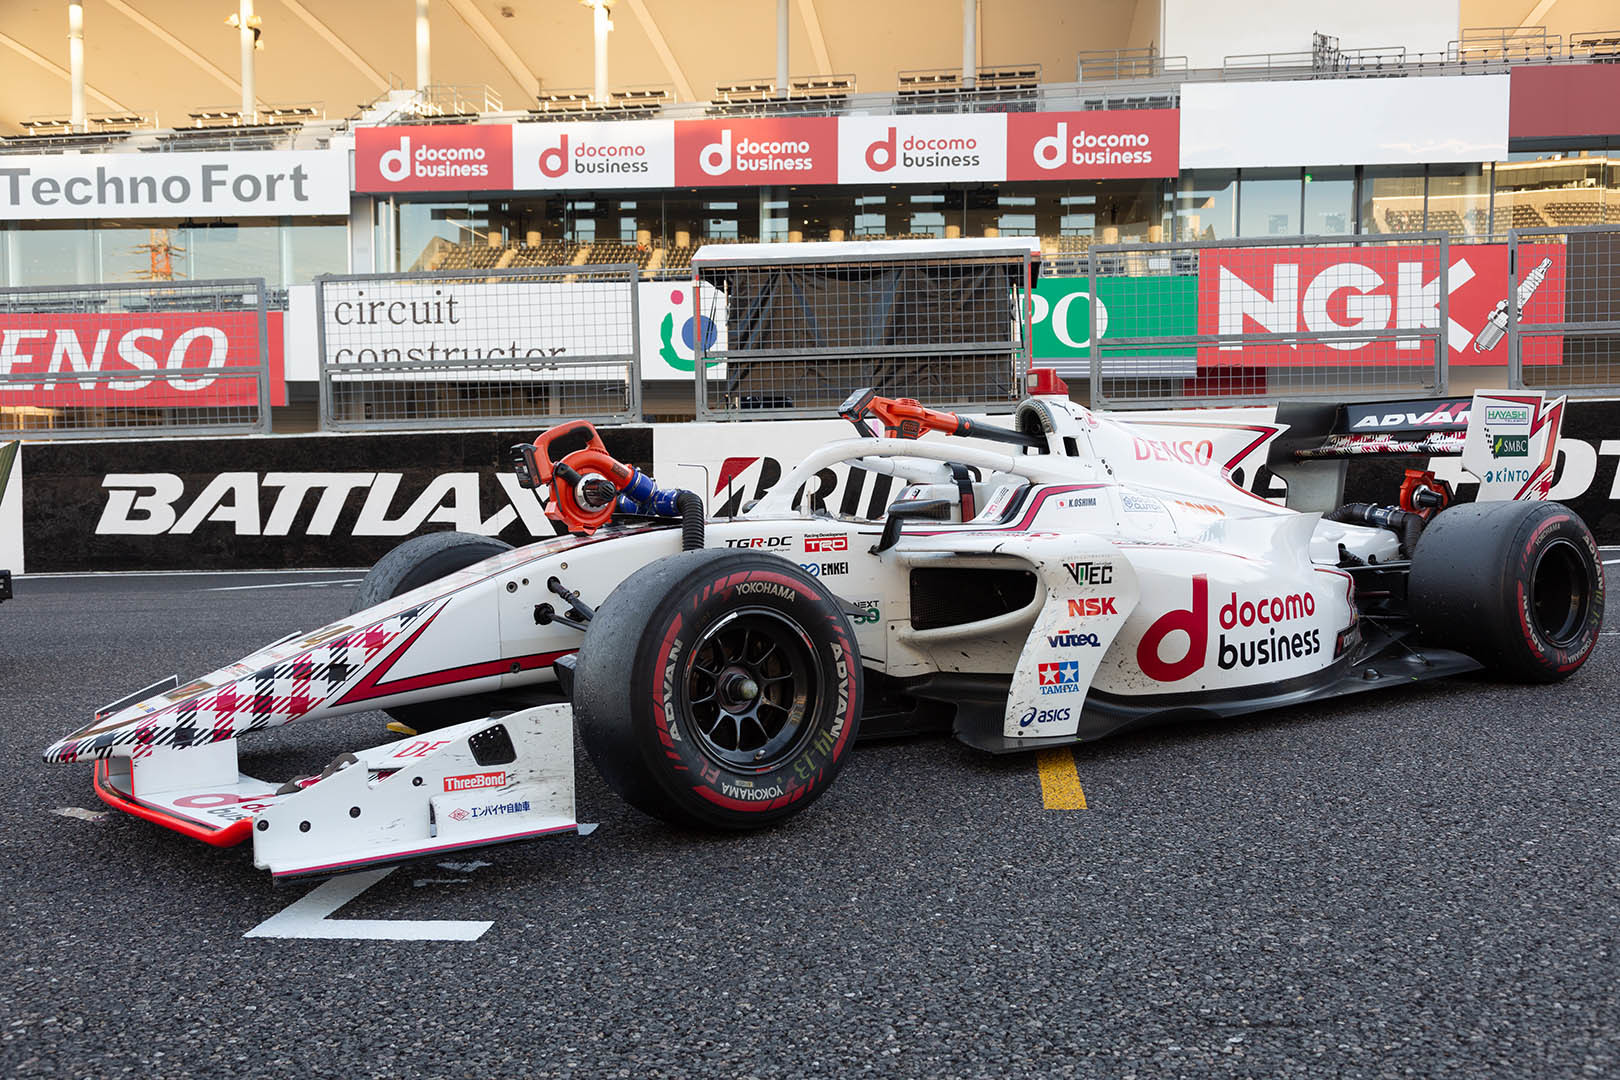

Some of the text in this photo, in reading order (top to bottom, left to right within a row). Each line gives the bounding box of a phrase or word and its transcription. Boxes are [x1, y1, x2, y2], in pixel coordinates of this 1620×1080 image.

[736, 138, 809, 155] docomo
[903, 136, 977, 151] docomo
[1072, 130, 1149, 148] docomo
[415, 145, 485, 162] docomo
[574, 142, 645, 158] docomo
[1072, 147, 1152, 165] business
[415, 160, 488, 177] business
[574, 157, 648, 174] business
[736, 154, 813, 172] business
[903, 152, 980, 168] business
[0, 164, 309, 206] Techno Fort
[334, 290, 461, 326] circuit
[1219, 257, 1476, 353] NGK
[335, 341, 566, 371] constructor
[1488, 411, 1526, 419] HAYASHI
[1133, 437, 1213, 466] DENSO
[1504, 440, 1527, 452] SMBC
[725, 536, 792, 548] TGR-DC
[806, 539, 847, 552] TRD
[821, 562, 848, 576] ENKEI
[736, 583, 796, 601] YOKOHAMA
[1068, 597, 1118, 616] NSK
[1219, 591, 1315, 630] docomo
[1217, 627, 1320, 670] business
[662, 639, 684, 742] ADVAN
[829, 642, 848, 738] ADVAN
[1040, 684, 1079, 695] TAMIYA
[445, 773, 505, 791] ThreeBond
[722, 782, 783, 800] YOKOHAMA
